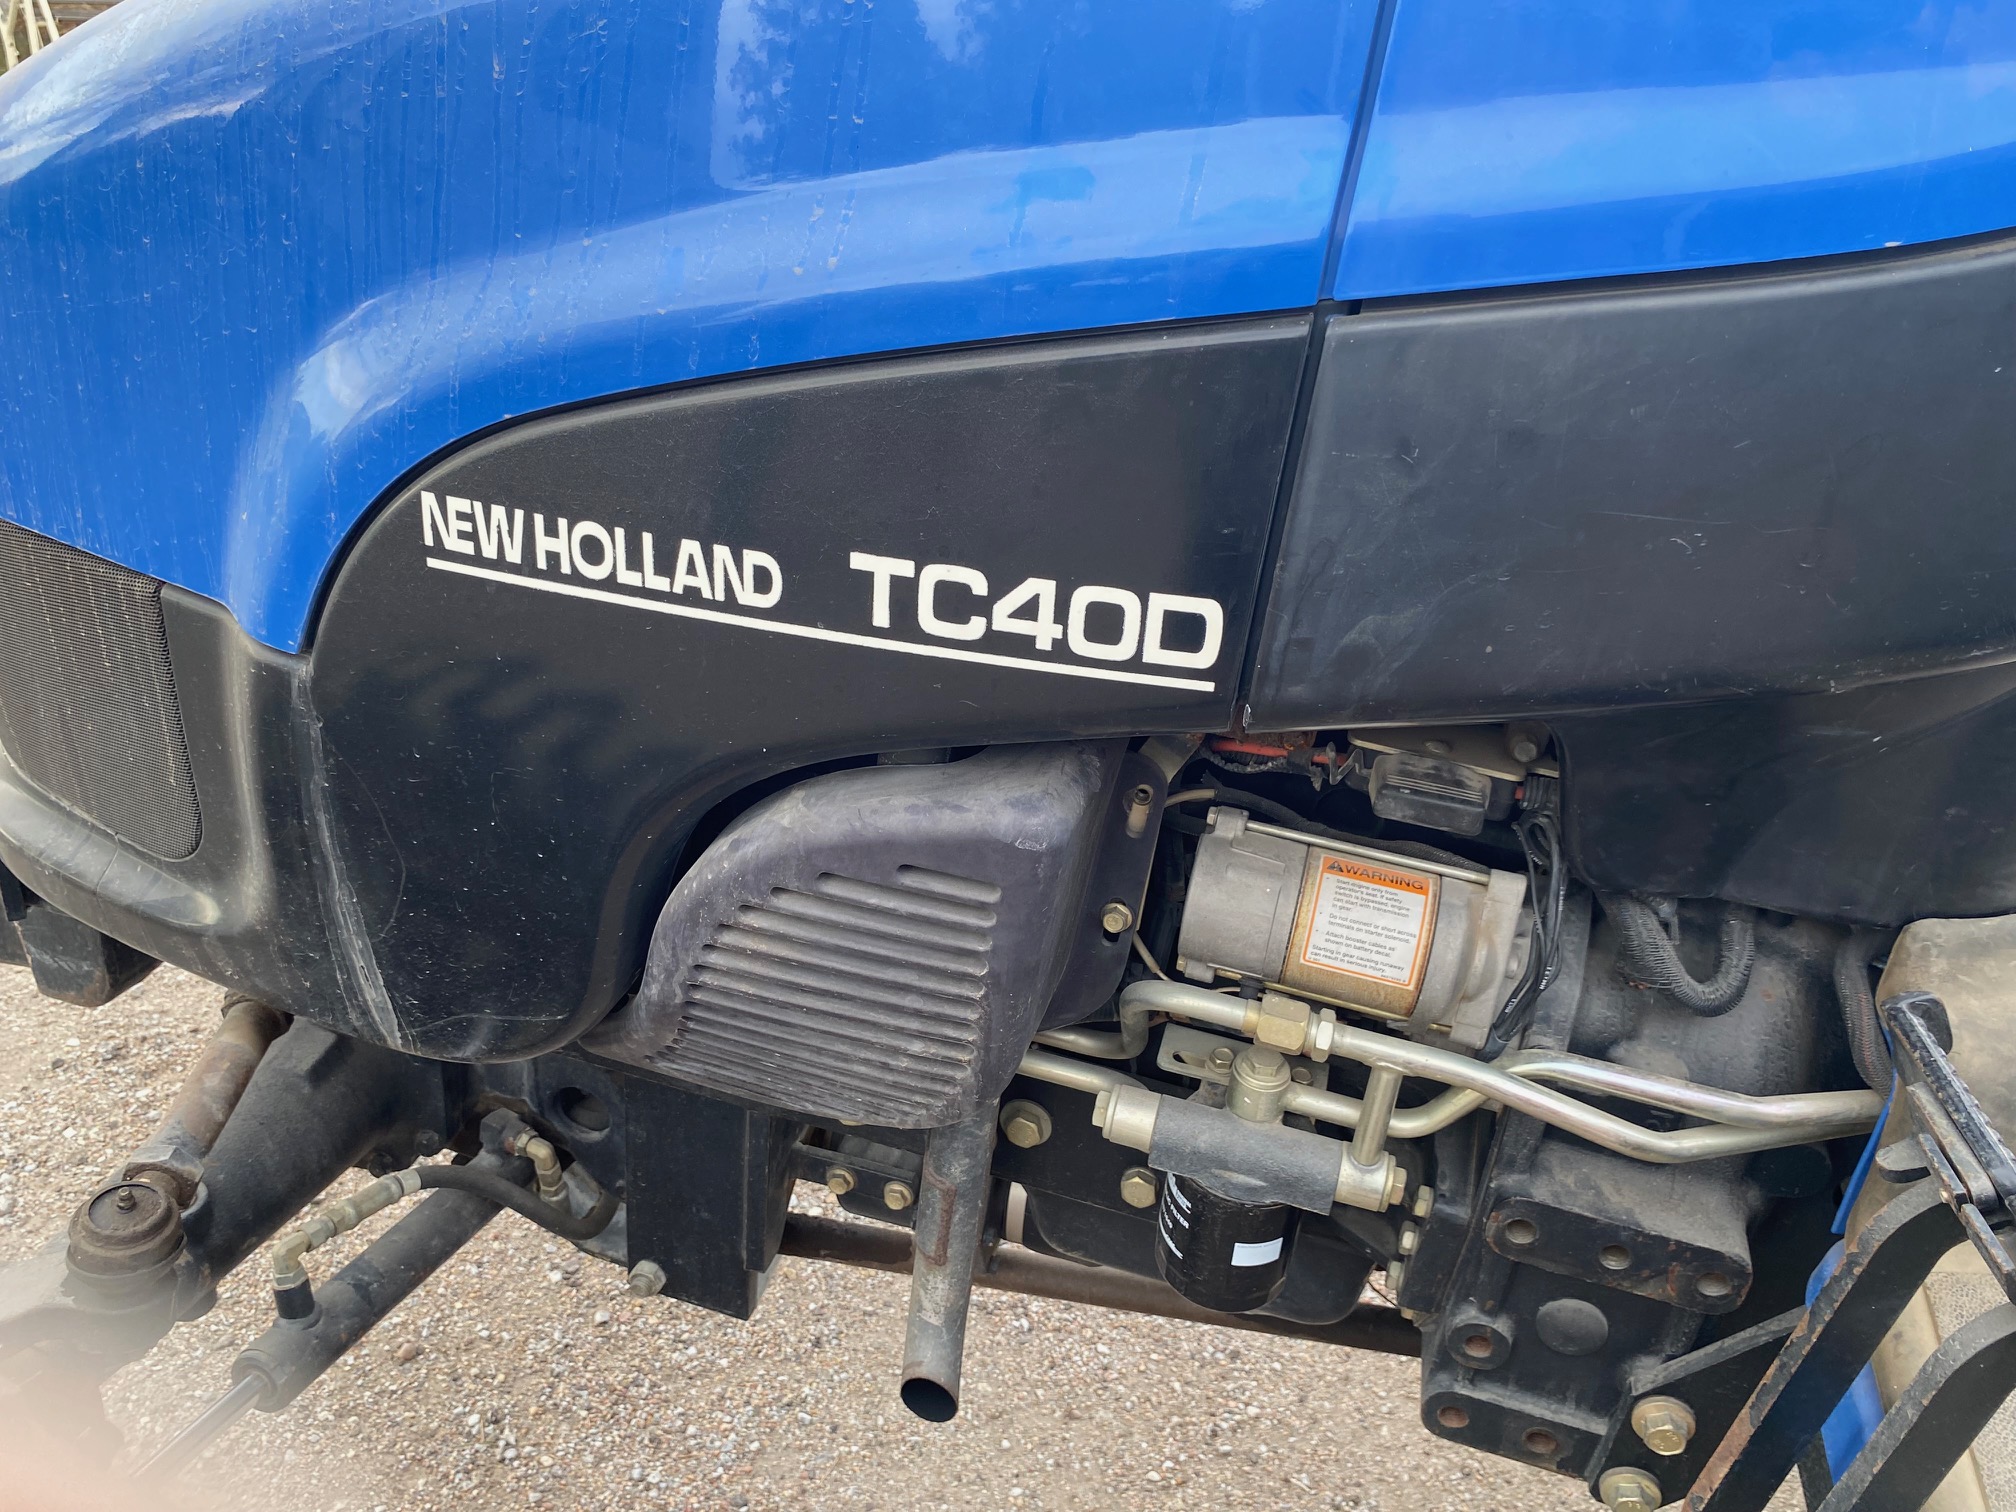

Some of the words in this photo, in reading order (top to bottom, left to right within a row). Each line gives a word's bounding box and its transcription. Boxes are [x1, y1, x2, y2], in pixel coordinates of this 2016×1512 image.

[420, 490, 524, 564] NEW
[533, 512, 783, 610] HOLLAND
[849, 551, 1224, 671] TC40D
[1336, 878, 1350, 886] Start
[1350, 882, 1370, 891] engine
[1371, 886, 1384, 894] only
[1344, 865, 1424, 890] WARNING
[1334, 890, 1353, 898] switch
[1360, 896, 1389, 907] bypassed,
[1390, 903, 1410, 912] engine
[1335, 884, 1364, 895] operator's
[1385, 896, 1402, 904] safety
[1372, 905, 1410, 918] transmission
[1328, 920, 1354, 931] terminals
[1364, 929, 1383, 937] starter
[1384, 933, 1410, 944] solenoid.
[1349, 917, 1372, 928] connect
[1381, 925, 1396, 933] short
[1397, 930, 1417, 938] across
[1324, 937, 1344, 946] shown
[1353, 944, 1374, 954] battery
[1374, 949, 1391, 958] decal.
[1325, 930, 1344, 939] Attach
[1345, 935, 1367, 945] booster
[1368, 941, 1387, 950] cables
[1312, 944, 1334, 955] Starting
[1341, 952, 1355, 960] gear
[1356, 955, 1379, 966] causing
[1379, 962, 1404, 972] runaway
[1322, 953, 1338, 961] result
[1346, 959, 1367, 968] serious
[1368, 964, 1385, 973] injury.
[1170, 1203, 1190, 1229] FILTER
